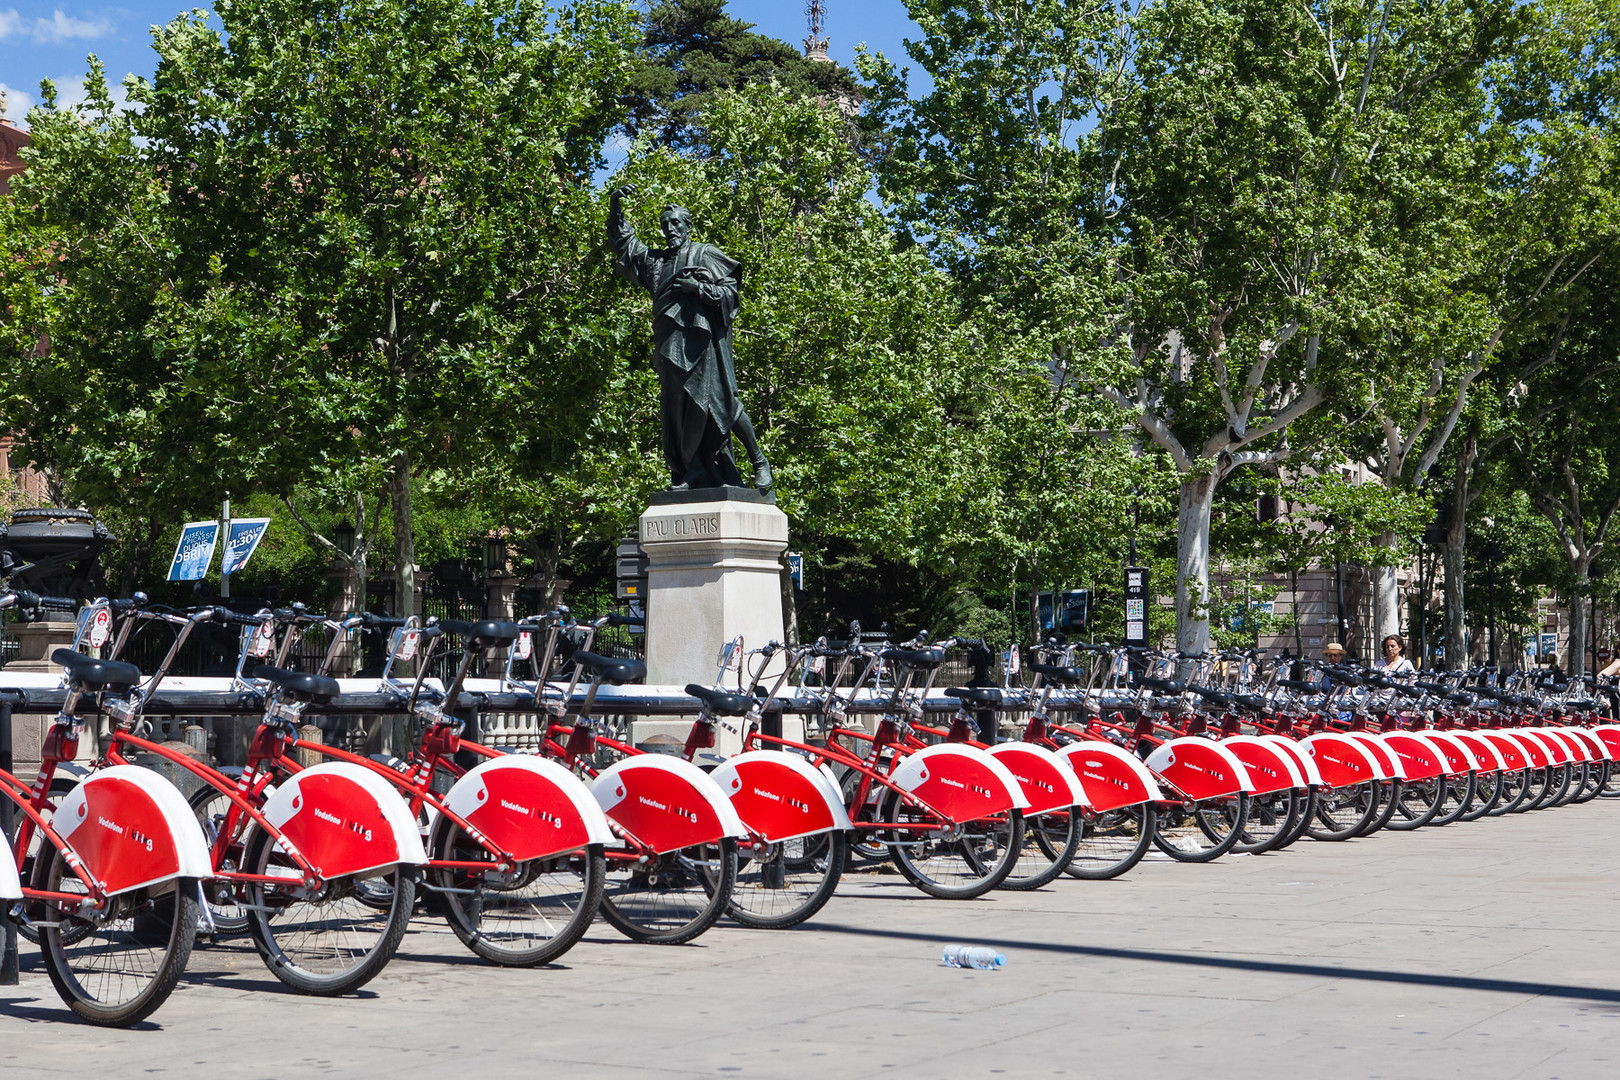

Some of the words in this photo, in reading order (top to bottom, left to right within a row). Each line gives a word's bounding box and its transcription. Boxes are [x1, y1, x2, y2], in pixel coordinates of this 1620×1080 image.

[645, 520, 669, 537] PAU
[674, 517, 718, 536] CLARIS
[183, 539, 208, 553] DIJOUS
[754, 787, 780, 801] Vodafone
[501, 799, 529, 815] Vodafone
[640, 796, 666, 810] Vodafone
[98, 816, 123, 834] Vodafone
[314, 808, 341, 826] Vodafone
